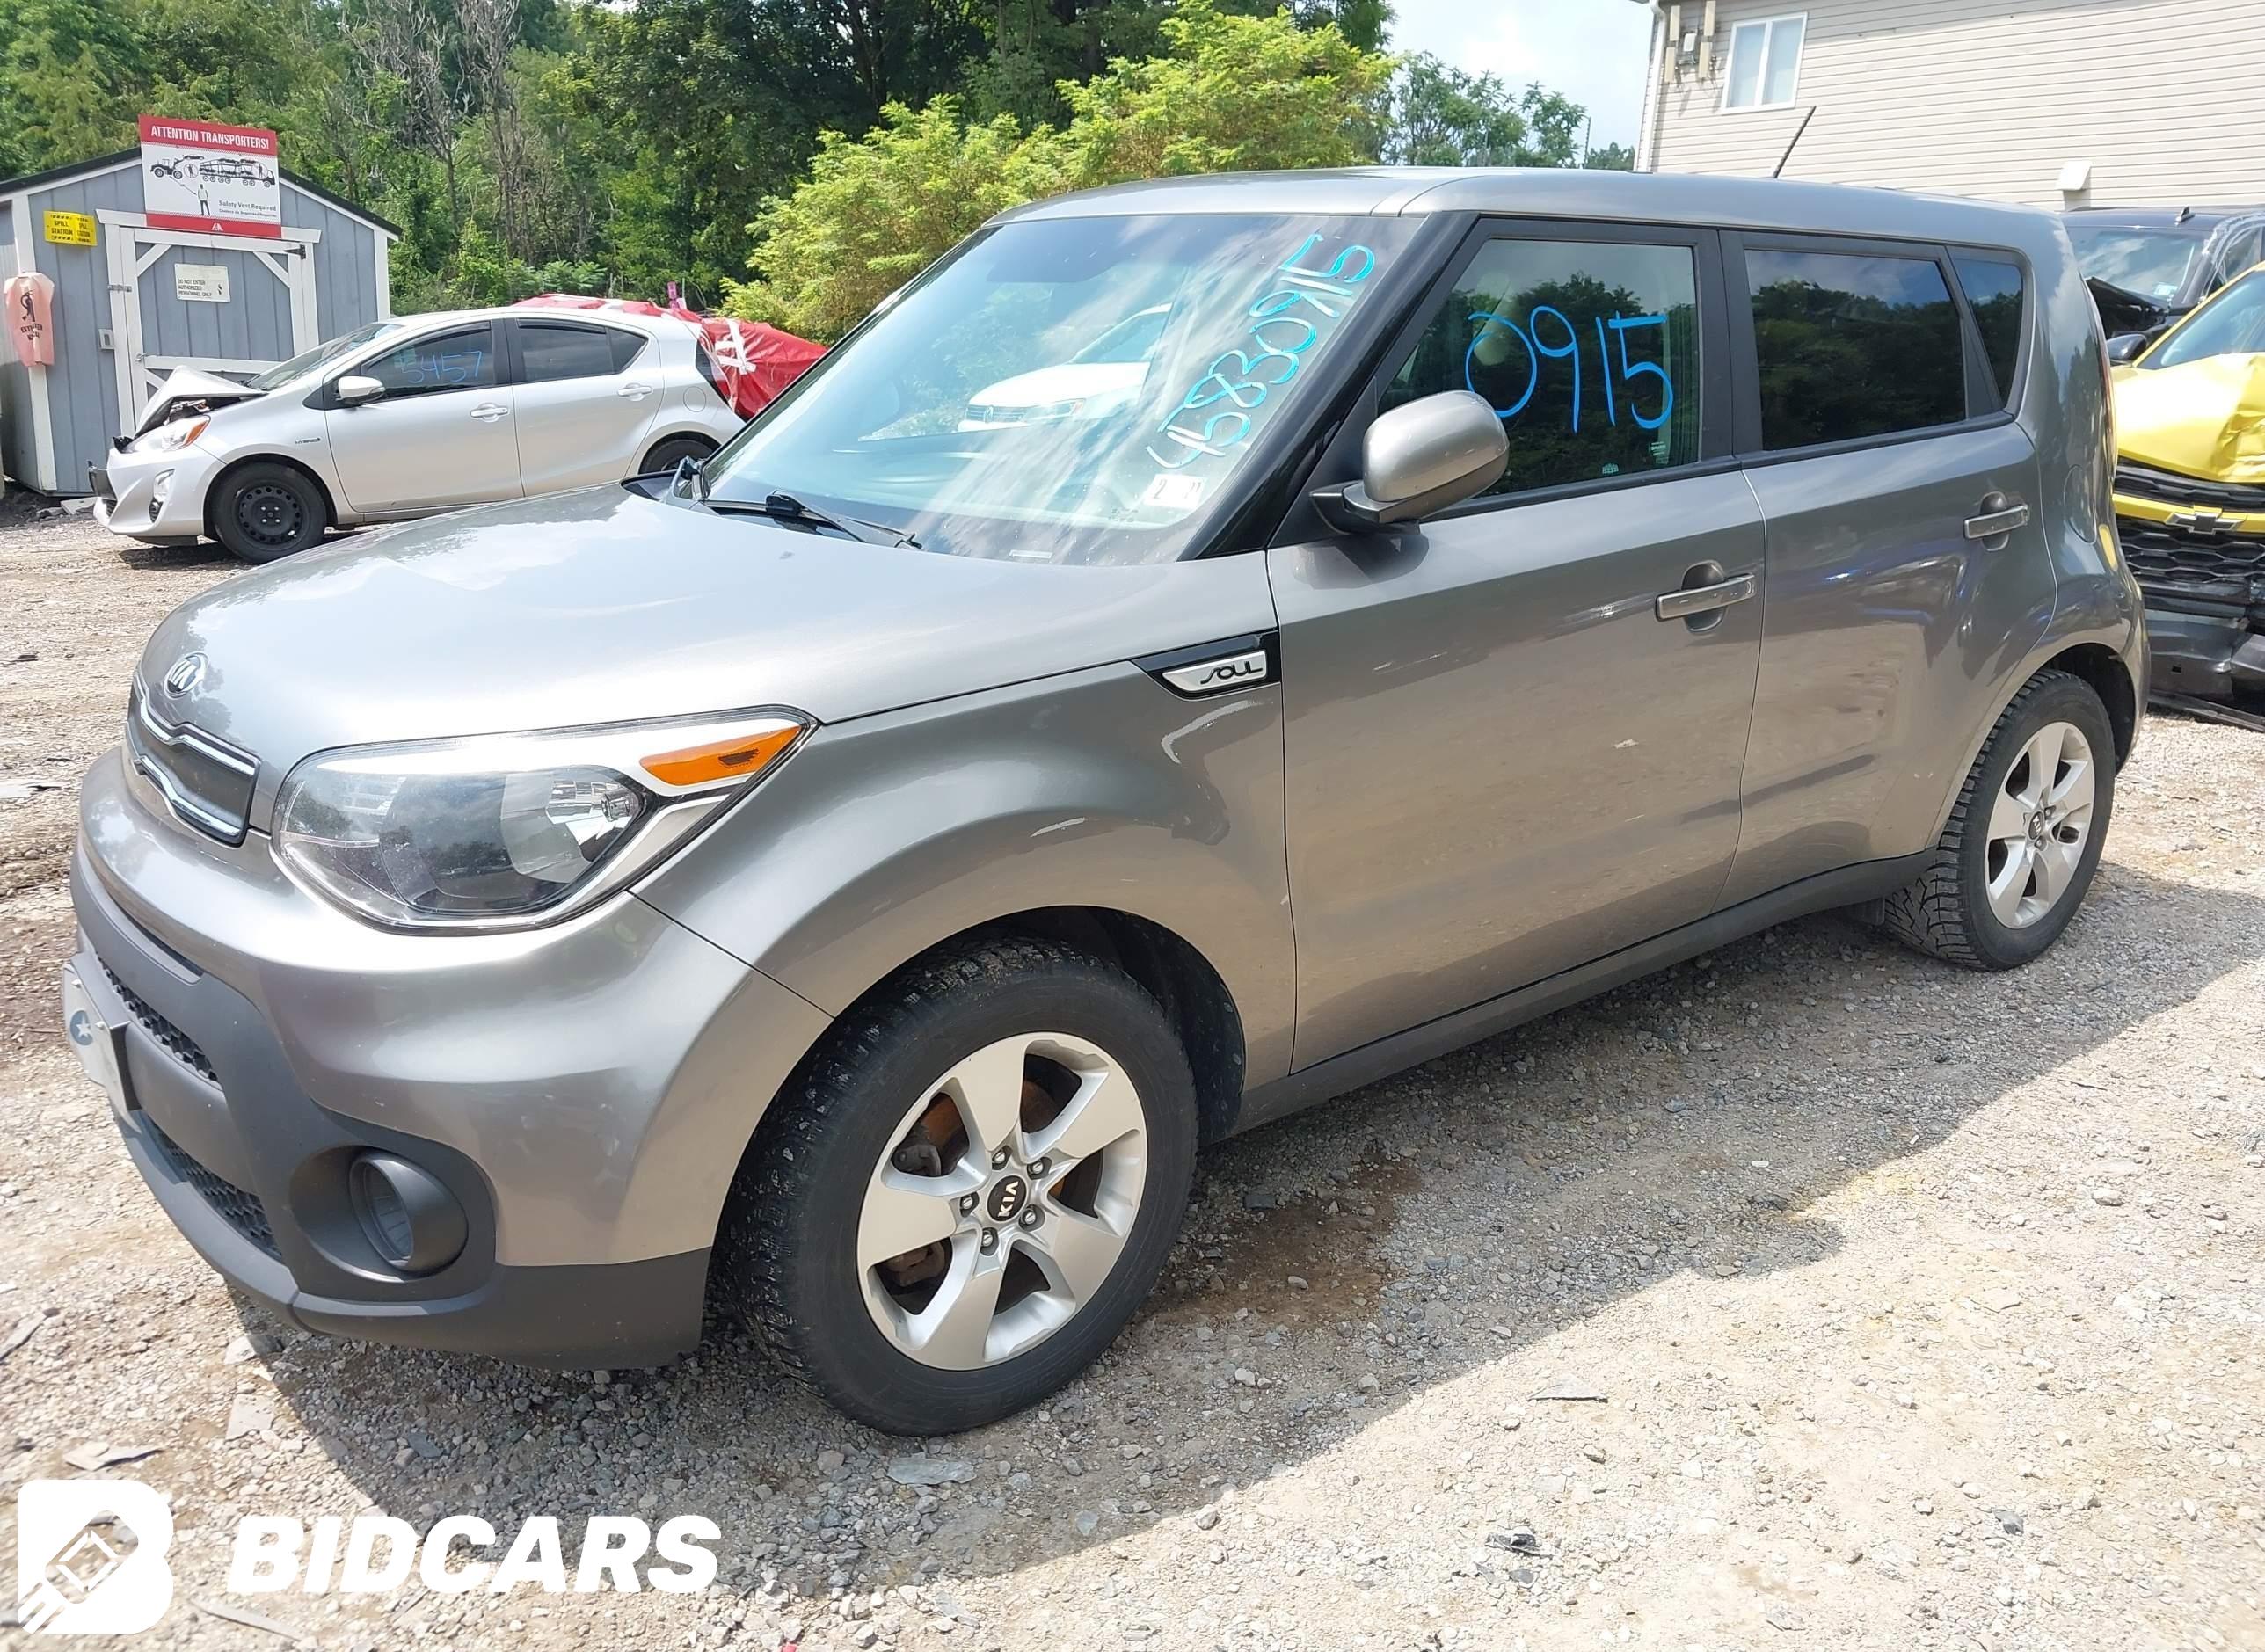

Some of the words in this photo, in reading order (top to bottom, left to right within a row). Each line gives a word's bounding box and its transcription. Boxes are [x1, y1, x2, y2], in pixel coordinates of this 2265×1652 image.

[151, 125, 199, 142] ATTENTION
[200, 131, 269, 149] TRANSPORTERS!
[400, 350, 483, 384] 5457
[1465, 305, 1674, 434] 0915
[1200, 660, 1264, 685] SOUL
[997, 1181, 1019, 1218] KIA
